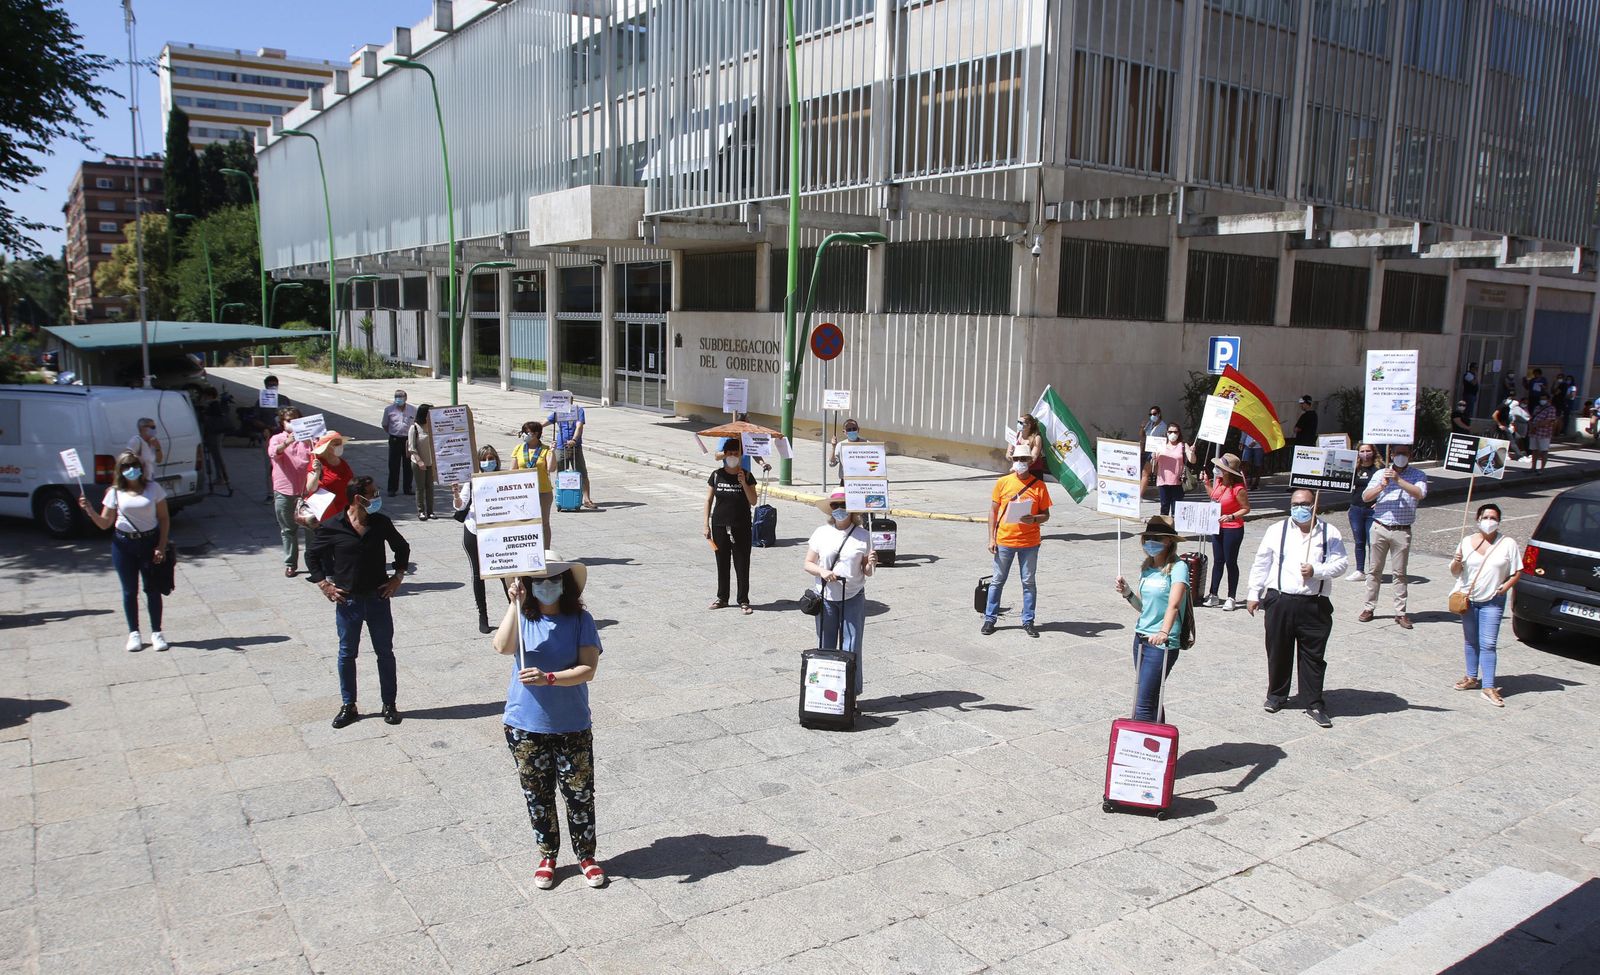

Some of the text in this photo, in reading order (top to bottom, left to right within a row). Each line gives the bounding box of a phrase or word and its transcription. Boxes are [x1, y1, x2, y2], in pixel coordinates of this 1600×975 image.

[700, 337, 780, 354] SUBDELEGACION
[1214, 341, 1234, 370] P
[700, 355, 780, 374] DEL GOBIERNO
[1293, 477, 1322, 486] AGENCIAS
[496, 484, 522, 493] ¡BASTA
[503, 533, 539, 542] REVISIÓN
